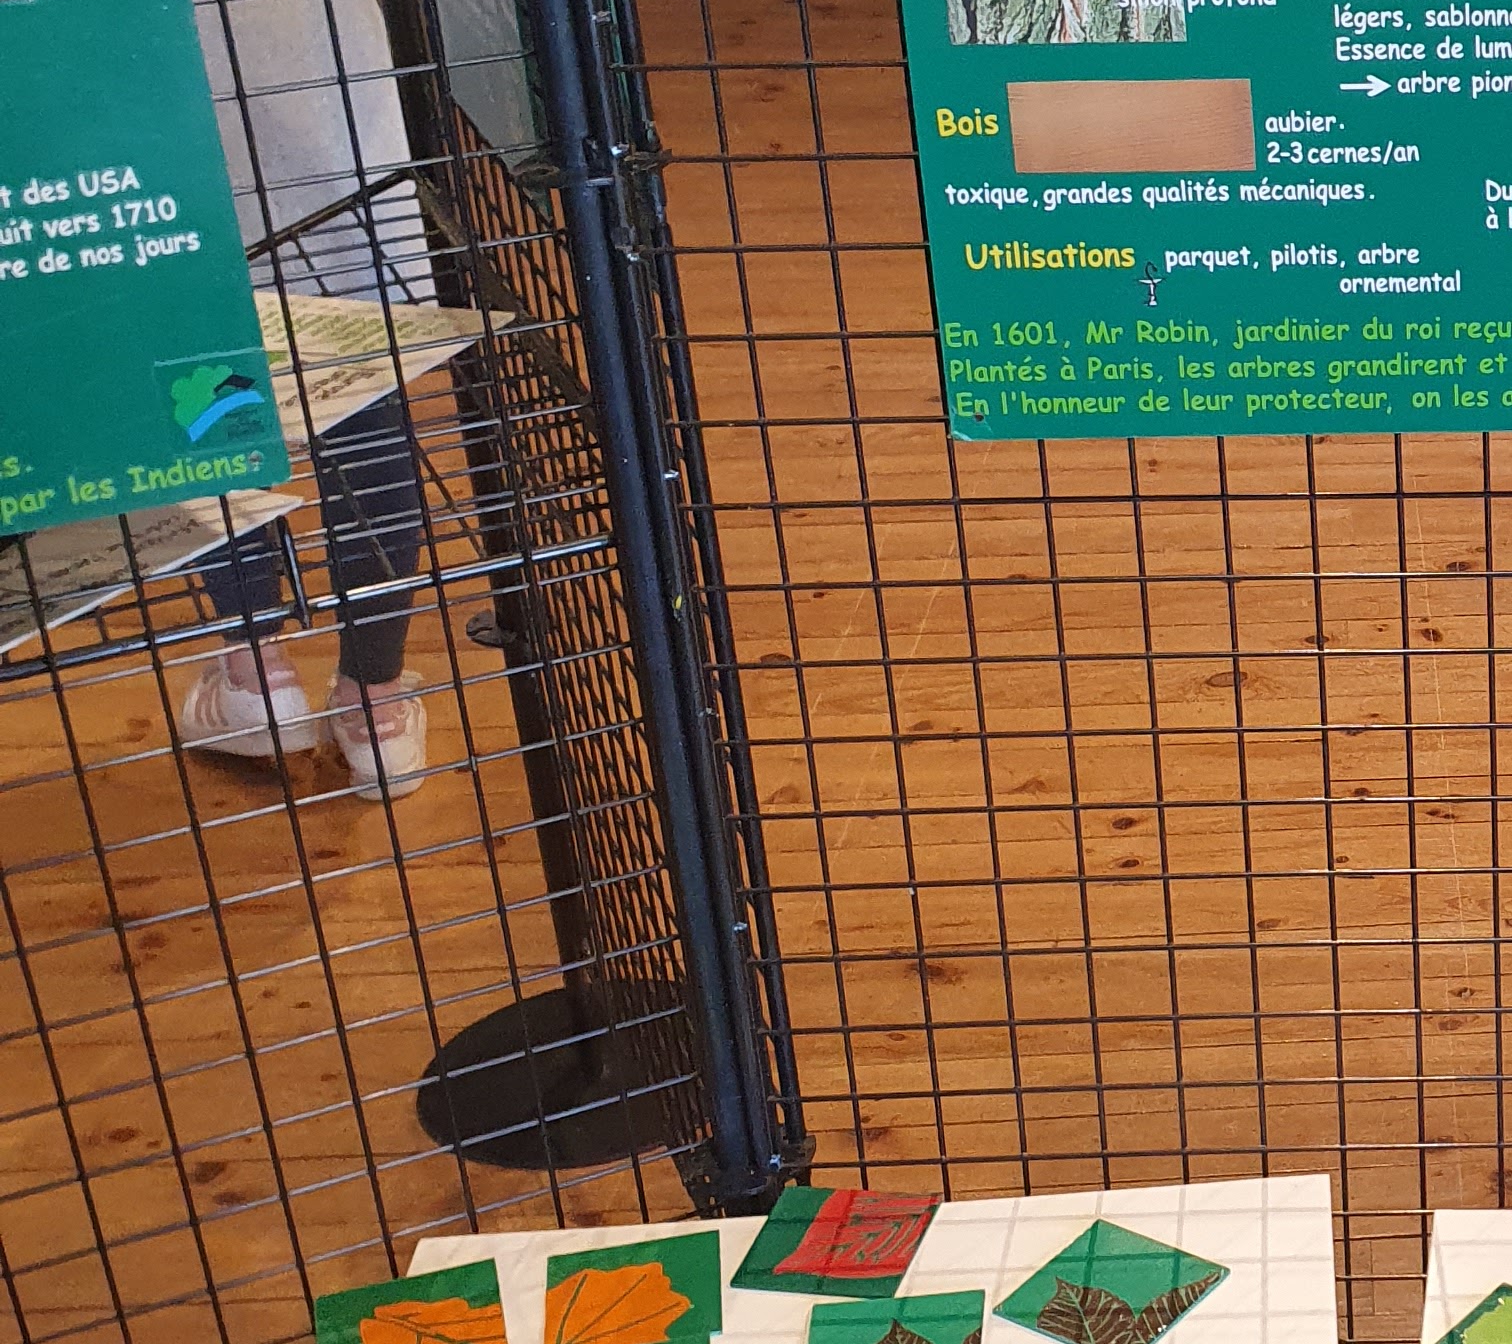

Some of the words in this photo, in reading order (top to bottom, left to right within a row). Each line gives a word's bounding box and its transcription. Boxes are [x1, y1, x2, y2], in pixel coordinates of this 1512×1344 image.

[1333, 2, 1413, 35] légers,
[1335, 37, 1426, 61] Essence
[1436, 37, 1464, 59] de
[1397, 71, 1461, 95] arbre
[935, 109, 999, 138] Bois
[1266, 143, 1304, 164] 2-3
[1307, 142, 1420, 165] cernes/an
[23, 179, 70, 206] des
[77, 166, 141, 198] USA
[945, 184, 1038, 209] toxique,
[1043, 181, 1133, 209] grandes
[1142, 178, 1230, 210] qualités
[1239, 177, 1376, 207] mécaniques.
[42, 212, 101, 239] vers
[112, 195, 178, 230] 1710
[1486, 206, 1500, 230] à
[38, 248, 72, 275] de
[80, 242, 124, 268] nos
[134, 230, 201, 267] jours
[964, 240, 1136, 271] Utilisations
[1165, 246, 1259, 273] parquet,
[1270, 244, 1347, 273] pilotis,
[1357, 244, 1420, 267] arbre
[1339, 271, 1461, 295] ornemental
[944, 322, 978, 349] En
[991, 321, 1071, 350] 1601,
[1086, 320, 1124, 346] Mr
[1136, 319, 1219, 348] Robin,
[1233, 317, 1350, 350] jardinier
[1361, 318, 1394, 341] du
[1405, 317, 1441, 340] roi
[949, 357, 1047, 385] Plantés
[1060, 356, 1077, 381] à
[1086, 356, 1165, 385] Paris,
[1178, 356, 1215, 380] les
[1228, 355, 1316, 380] arbres
[1327, 353, 1467, 383] grandirent
[1478, 352, 1508, 376] et
[955, 392, 990, 418] En
[1000, 392, 1126, 417] l'honneur
[1138, 390, 1171, 413] de
[1182, 389, 1234, 413] leur
[1246, 389, 1393, 417] protecteur,
[1411, 390, 1442, 408] on
[1453, 385, 1489, 408] les
[0, 487, 55, 525] par
[67, 476, 117, 506] les
[126, 453, 247, 493] Indiens
